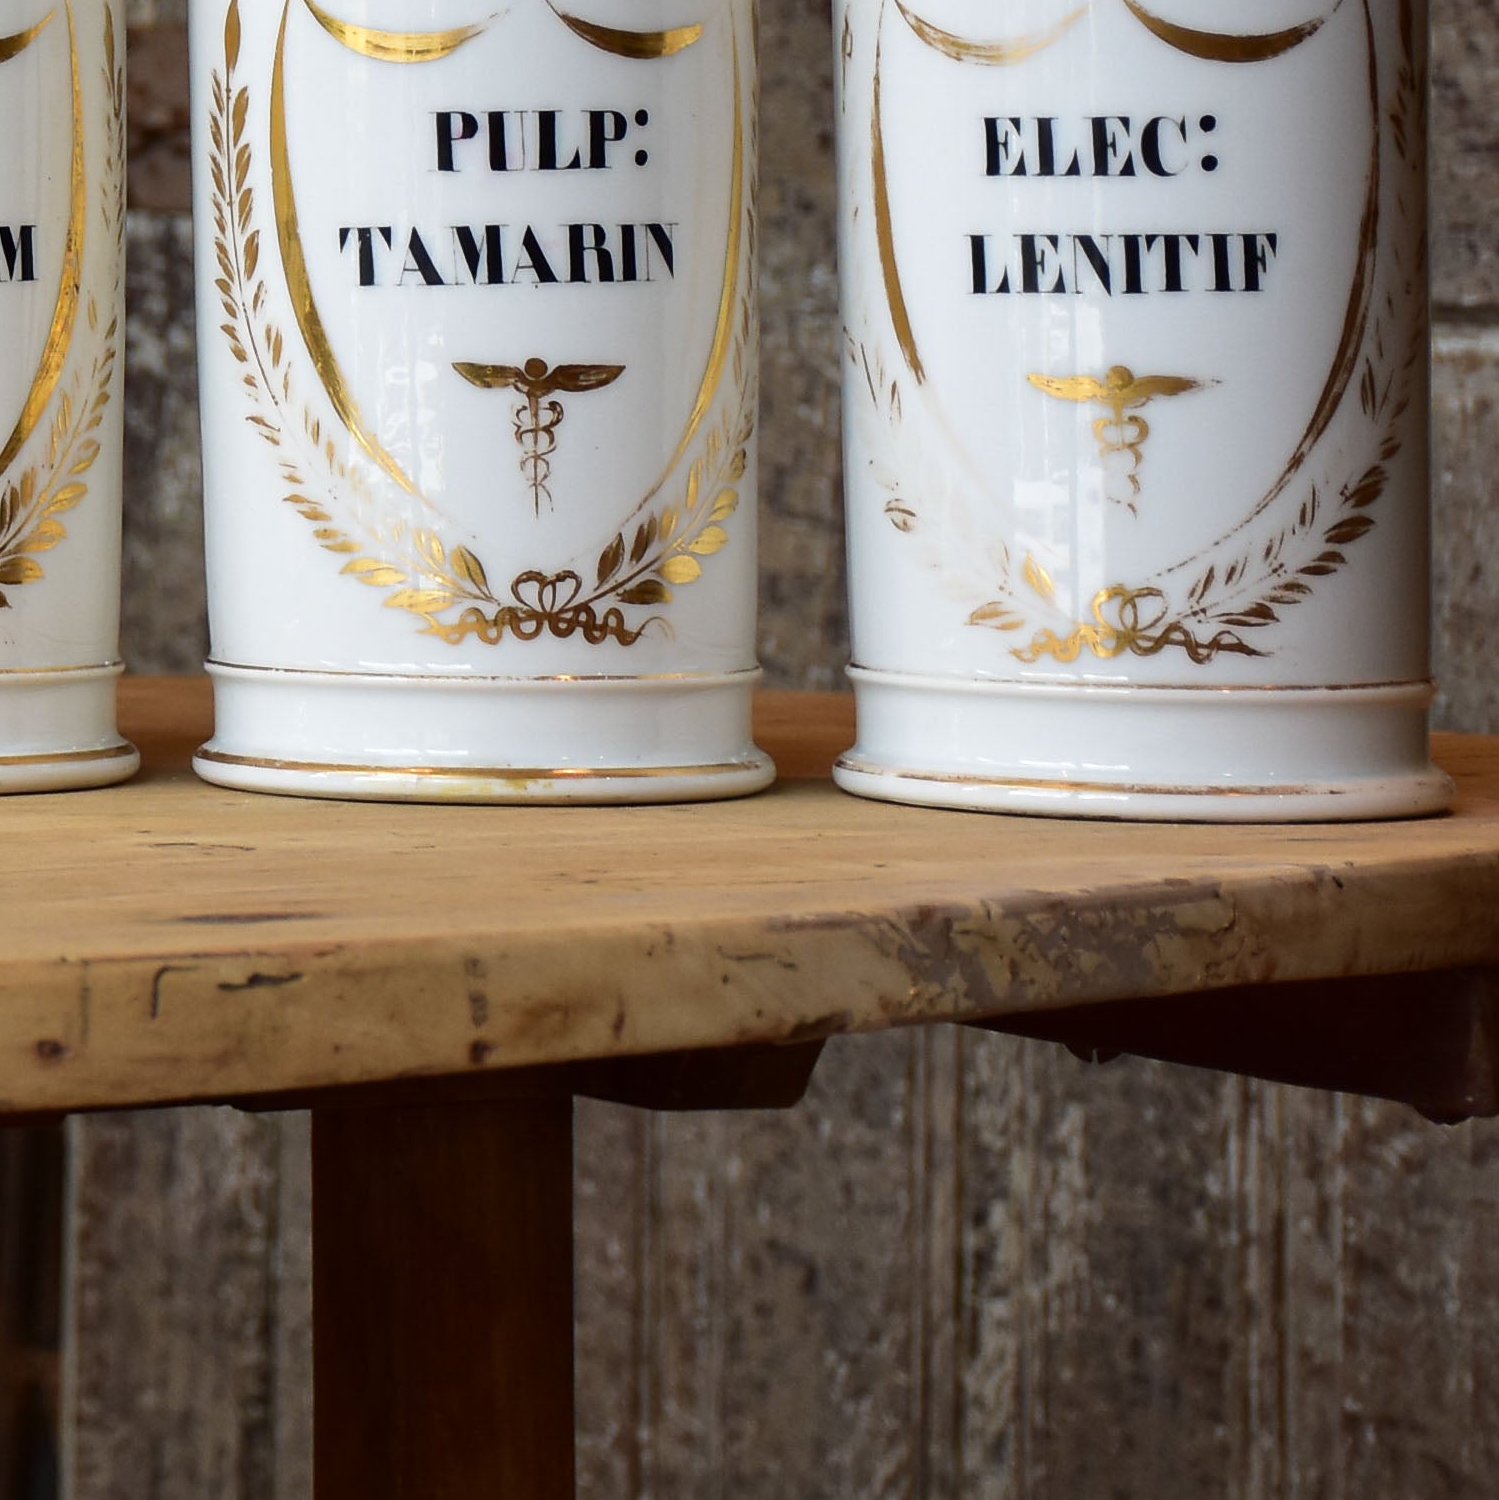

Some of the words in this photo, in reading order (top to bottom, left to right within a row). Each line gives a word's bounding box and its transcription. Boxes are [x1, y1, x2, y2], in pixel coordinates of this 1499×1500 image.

[428, 107, 650, 174] PULP:
[983, 113, 1220, 178] ELEC:
[338, 220, 679, 289] TAMARIN
[968, 231, 1279, 297] LENITIF
